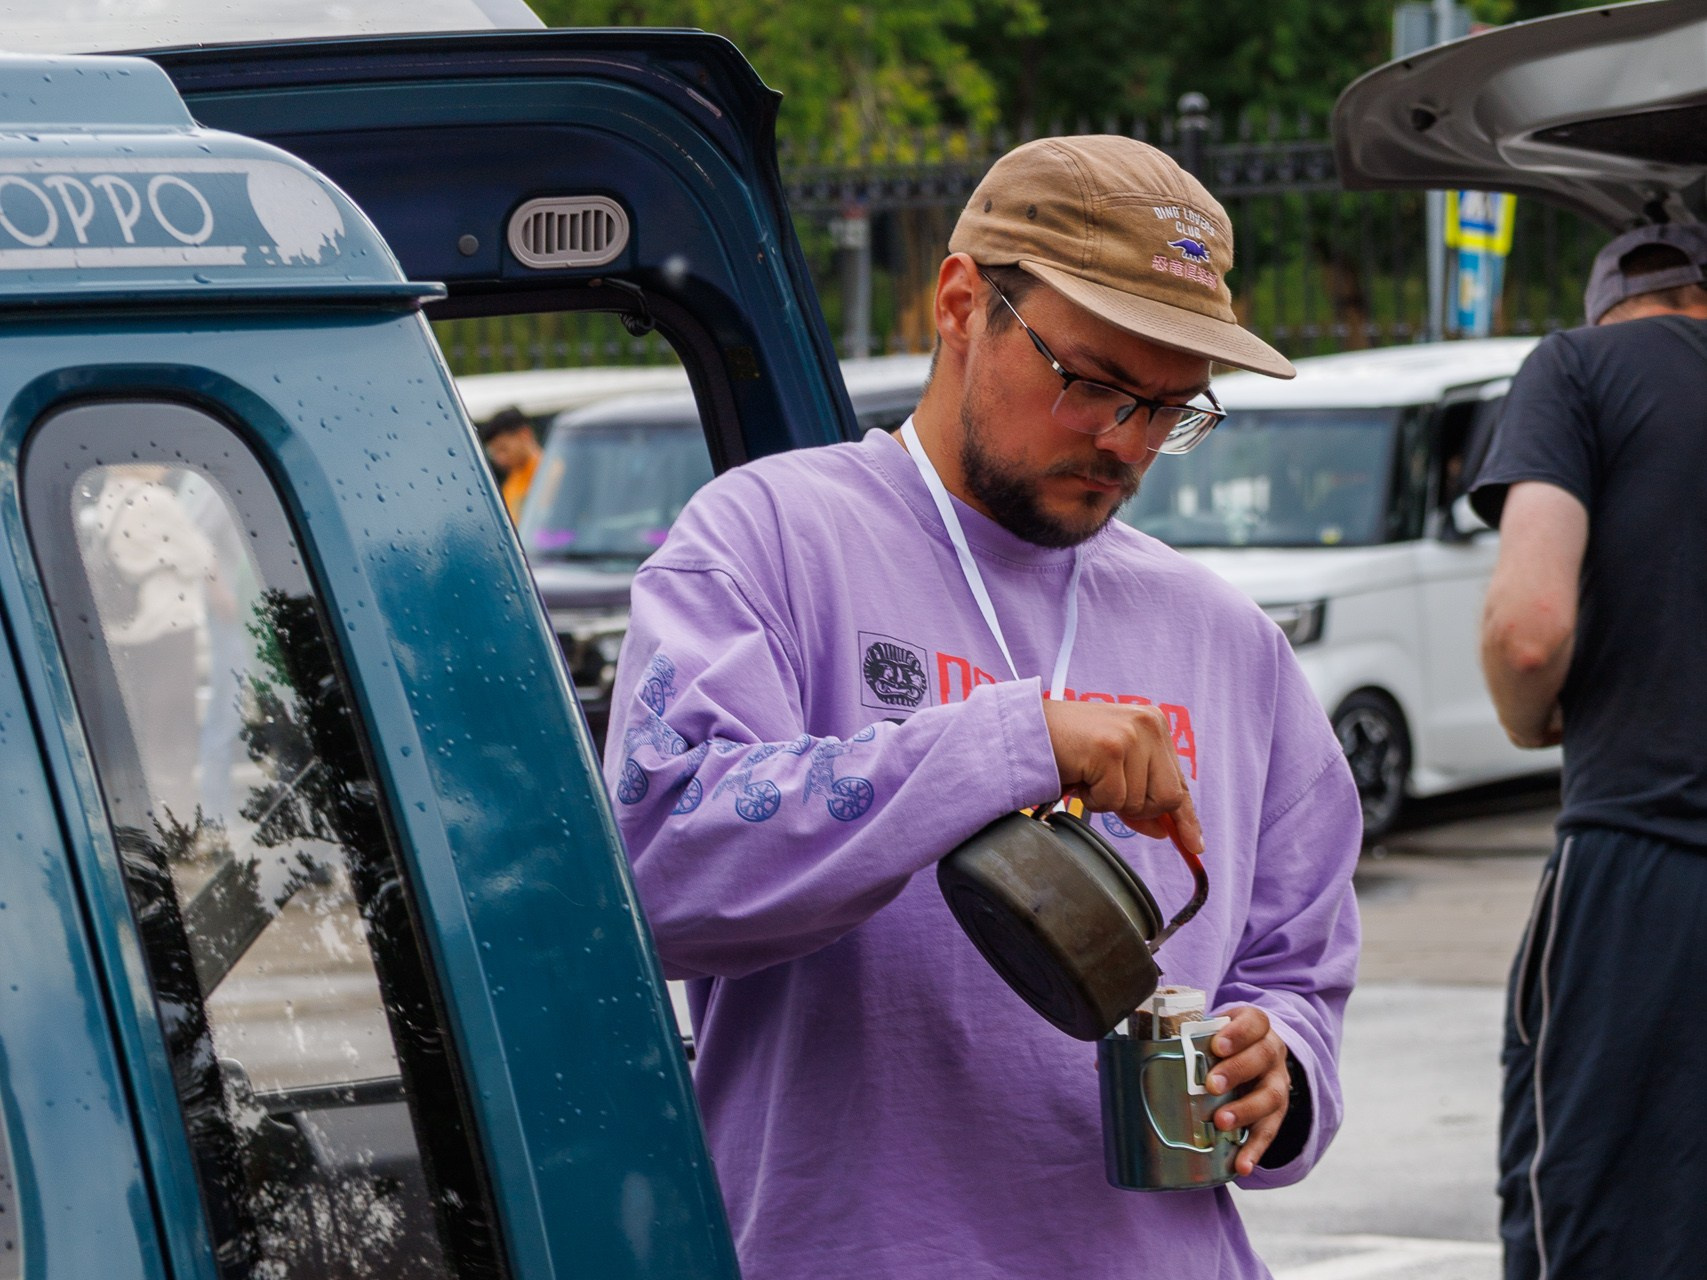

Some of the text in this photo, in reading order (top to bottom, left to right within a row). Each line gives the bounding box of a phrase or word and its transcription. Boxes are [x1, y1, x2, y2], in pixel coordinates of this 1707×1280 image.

[1153, 206, 1216, 237] DINO LOVERS
[1175, 221, 1202, 239] CLUB
